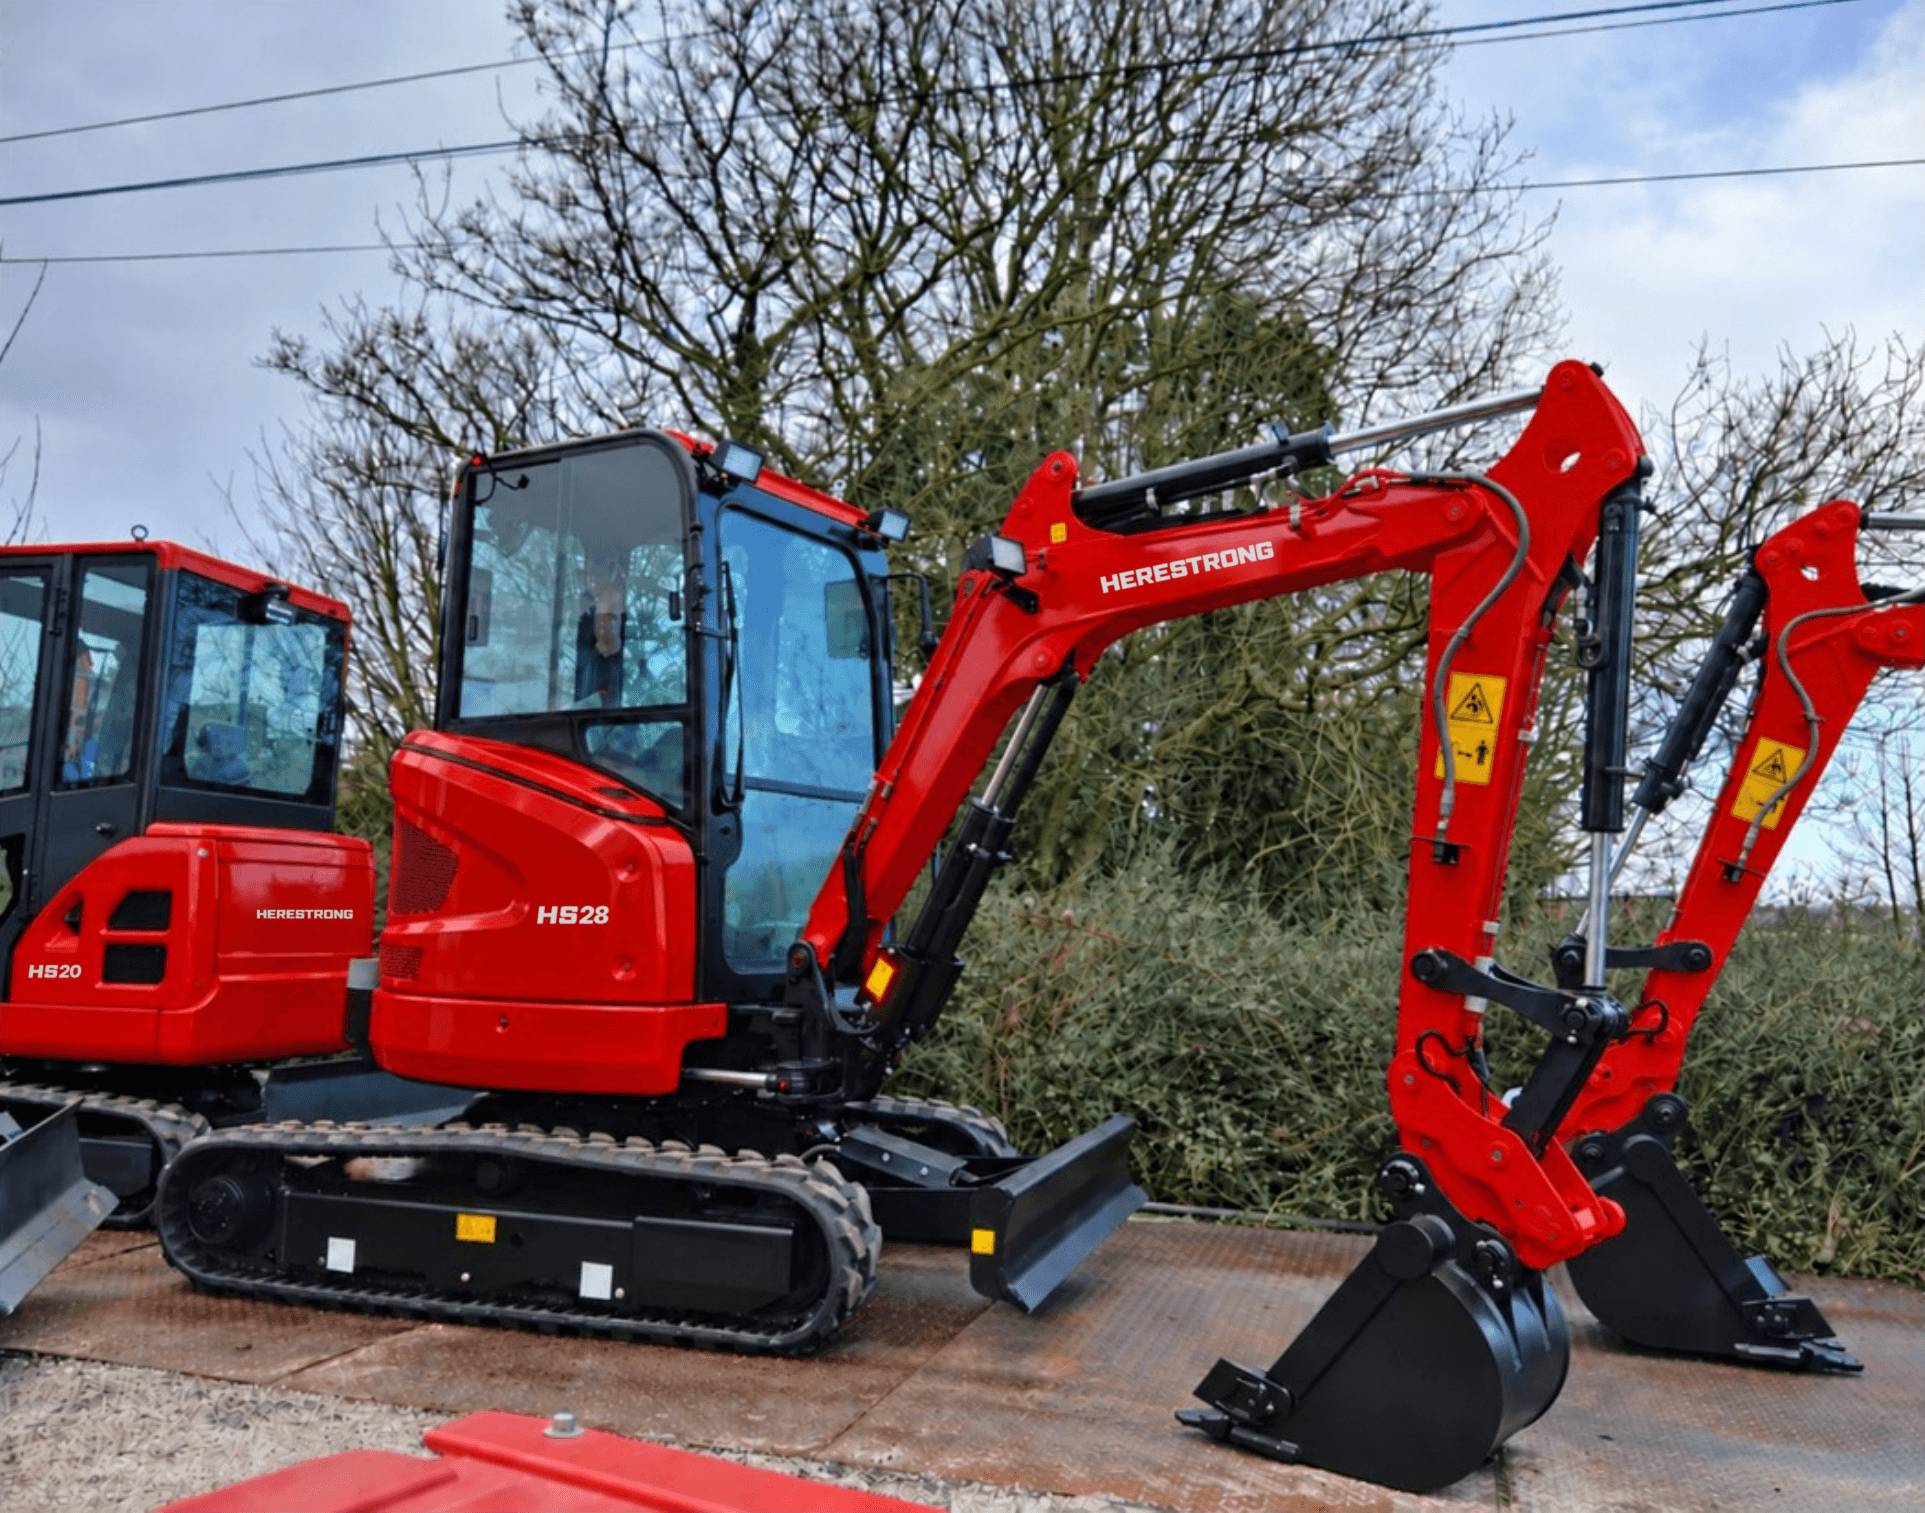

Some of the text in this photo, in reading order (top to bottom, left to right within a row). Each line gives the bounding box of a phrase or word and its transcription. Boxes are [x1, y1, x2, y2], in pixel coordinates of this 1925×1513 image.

[1100, 541, 1275, 594] HERESTRONG
[256, 909, 354, 920] HERESTRONG
[537, 905, 610, 925] HS28
[28, 964, 83, 979] HS20
